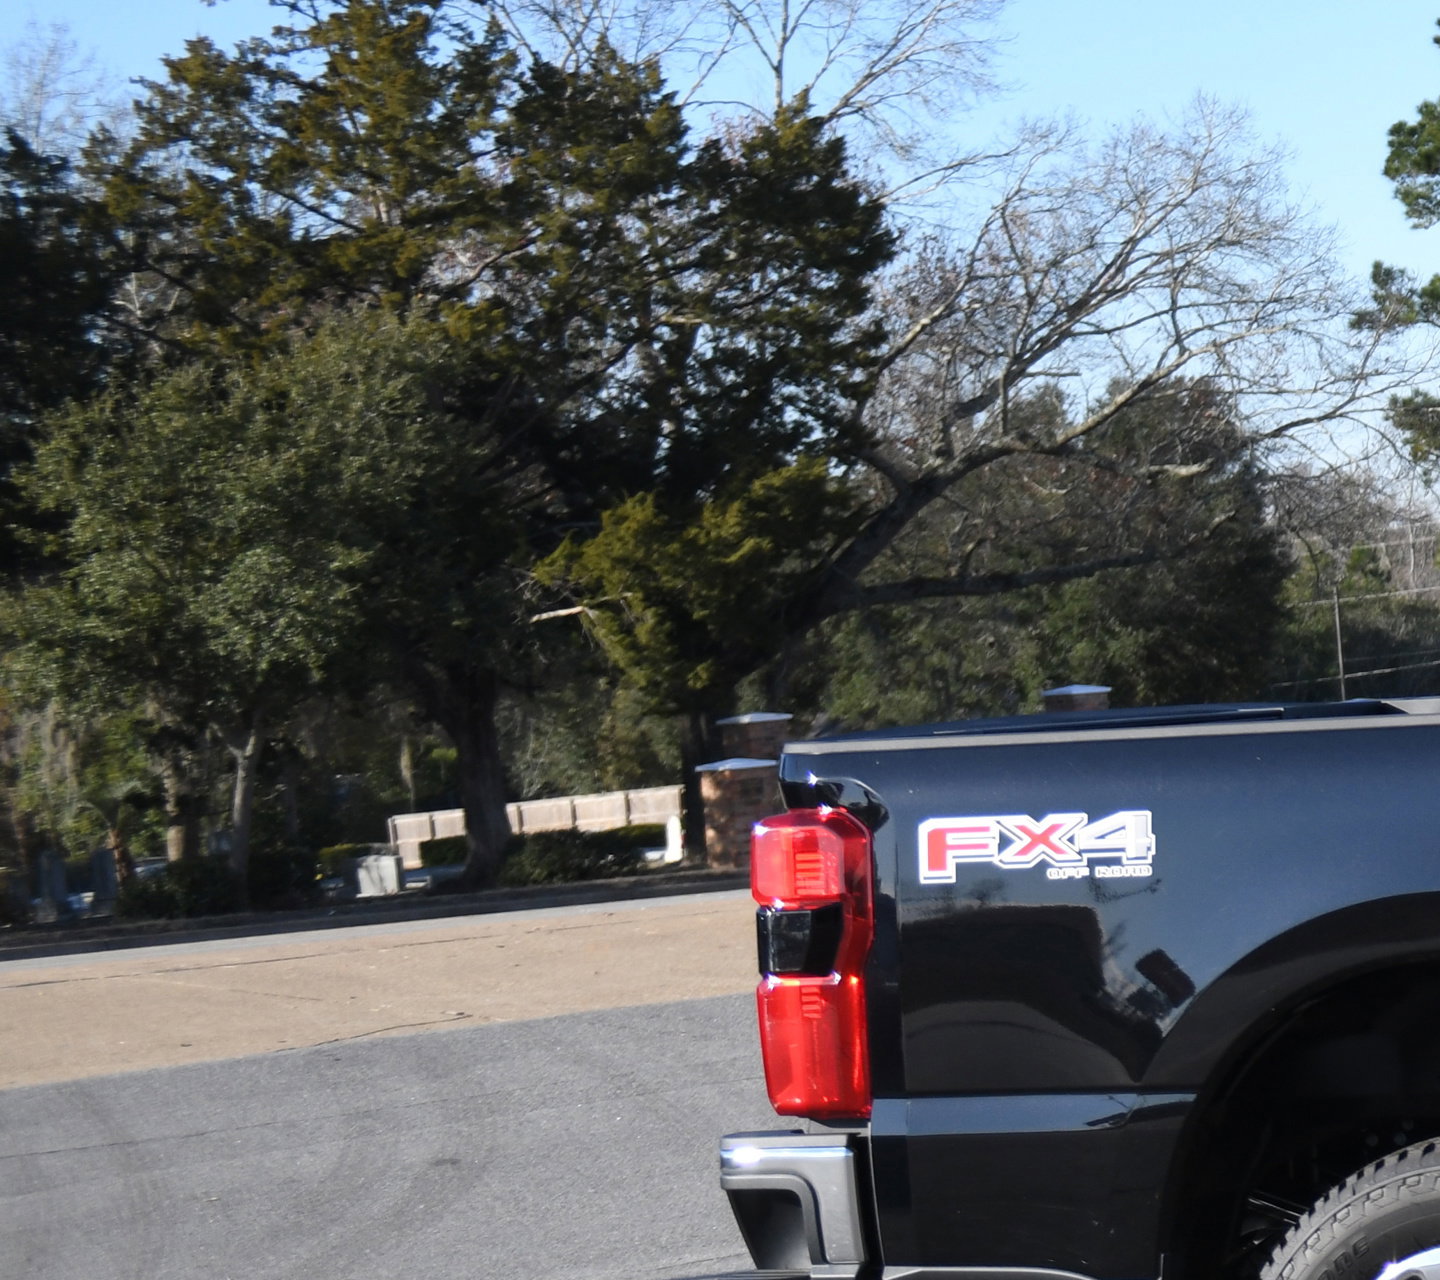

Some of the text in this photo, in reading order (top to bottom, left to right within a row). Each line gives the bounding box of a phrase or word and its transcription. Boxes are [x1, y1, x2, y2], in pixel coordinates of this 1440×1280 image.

[918, 810, 1156, 885] FX4
[1046, 864, 1153, 880] OFF ROAD
